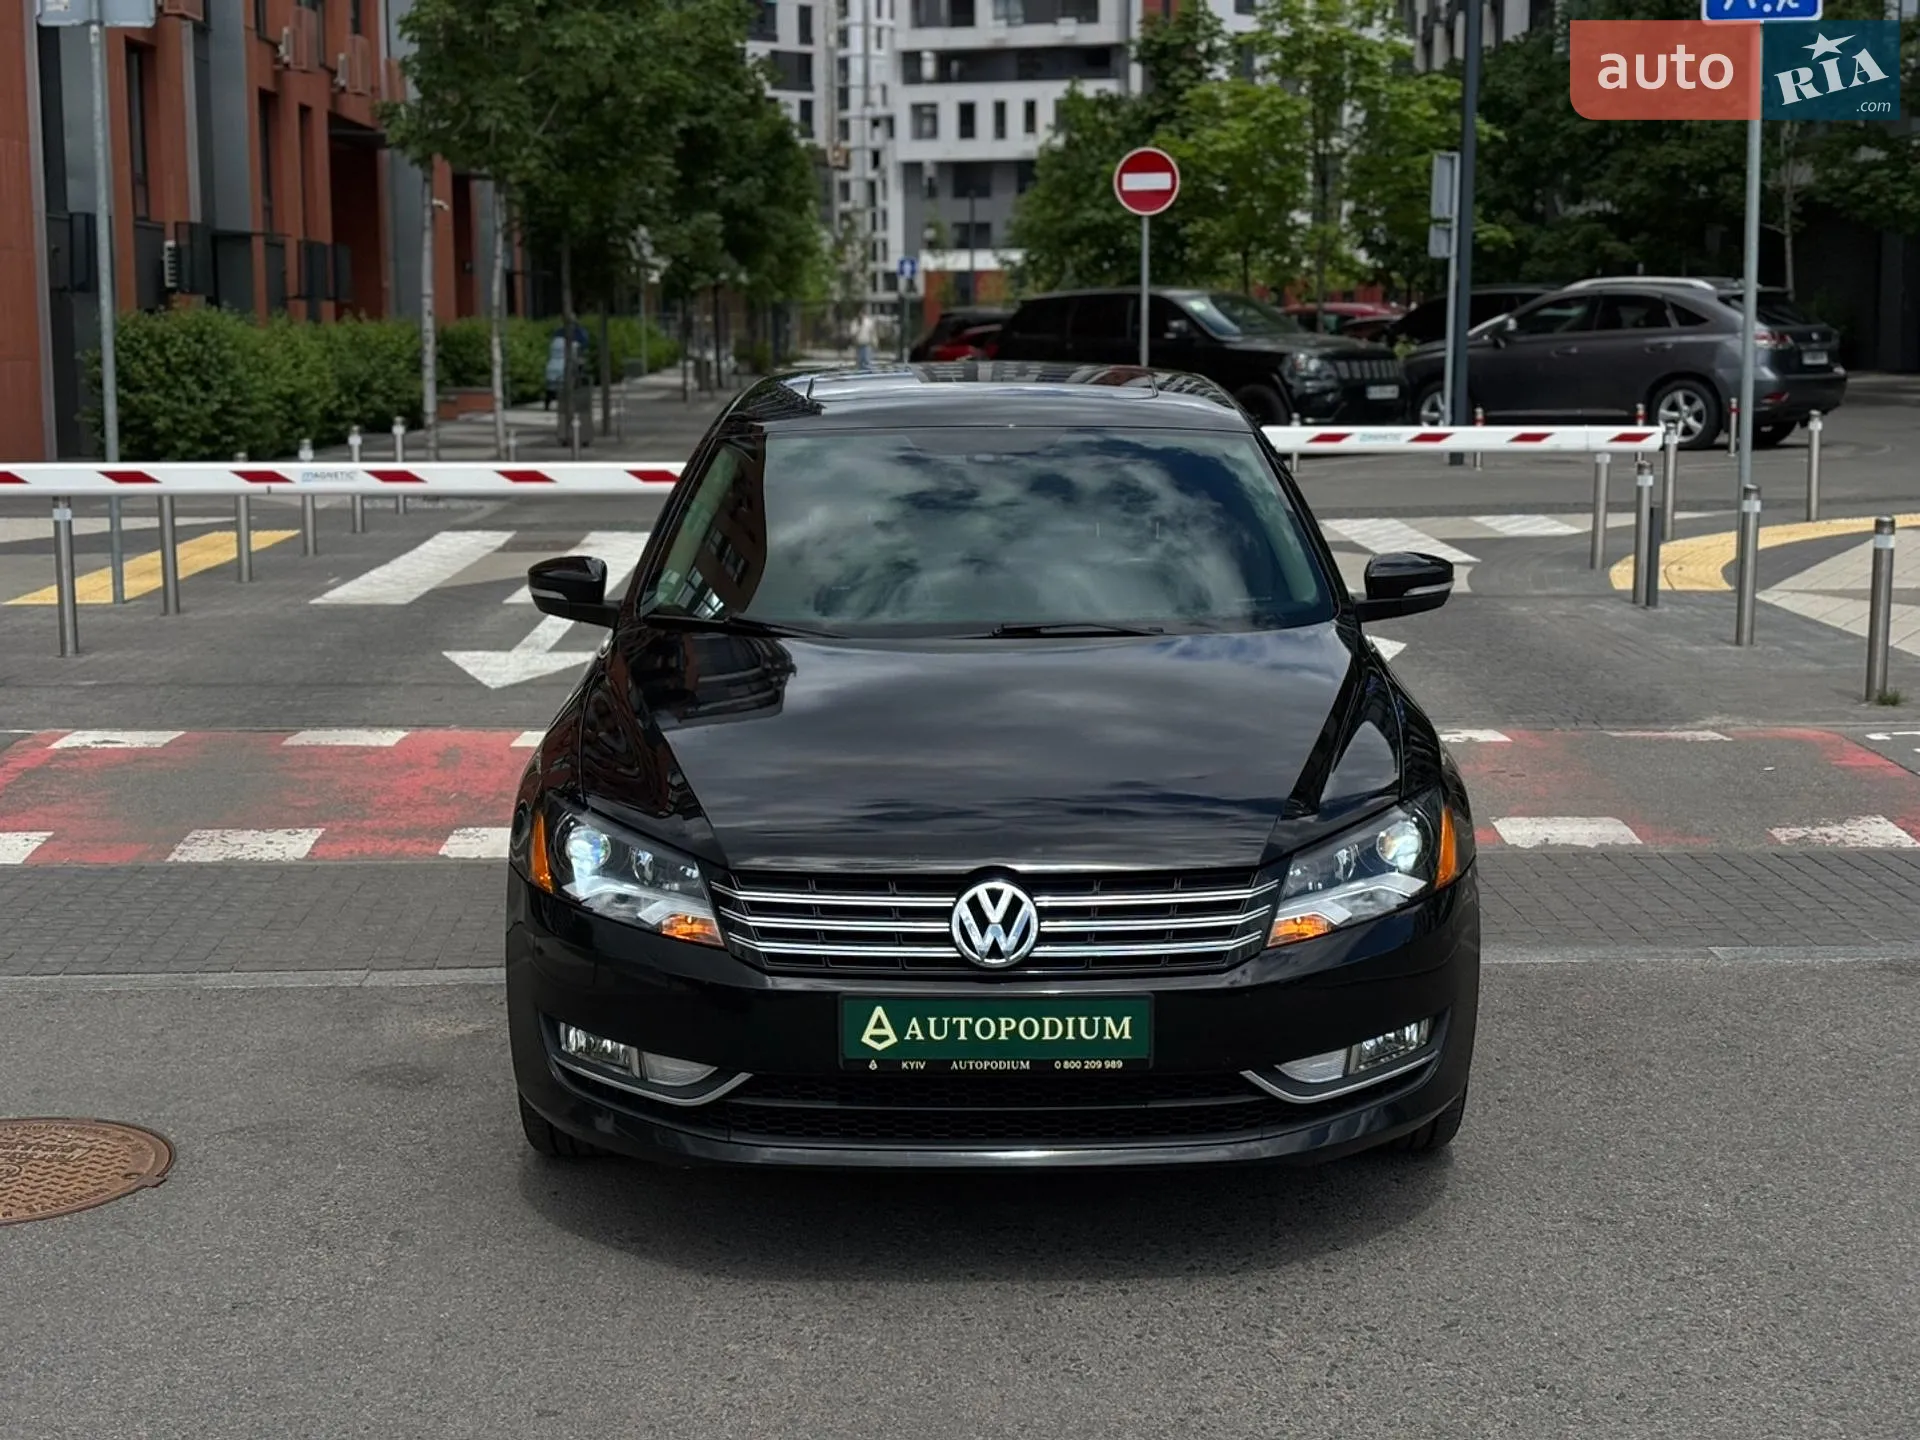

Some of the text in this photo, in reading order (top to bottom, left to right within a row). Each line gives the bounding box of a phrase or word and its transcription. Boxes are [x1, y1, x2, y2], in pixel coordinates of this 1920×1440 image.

[903, 1016, 1132, 1040] AUTOPODIUM
[901, 1060, 926, 1070] KYIV
[951, 1060, 1030, 1070] AUTOPODIUM
[1063, 1060, 1082, 1070] 800
[1084, 1060, 1102, 1070] 209
